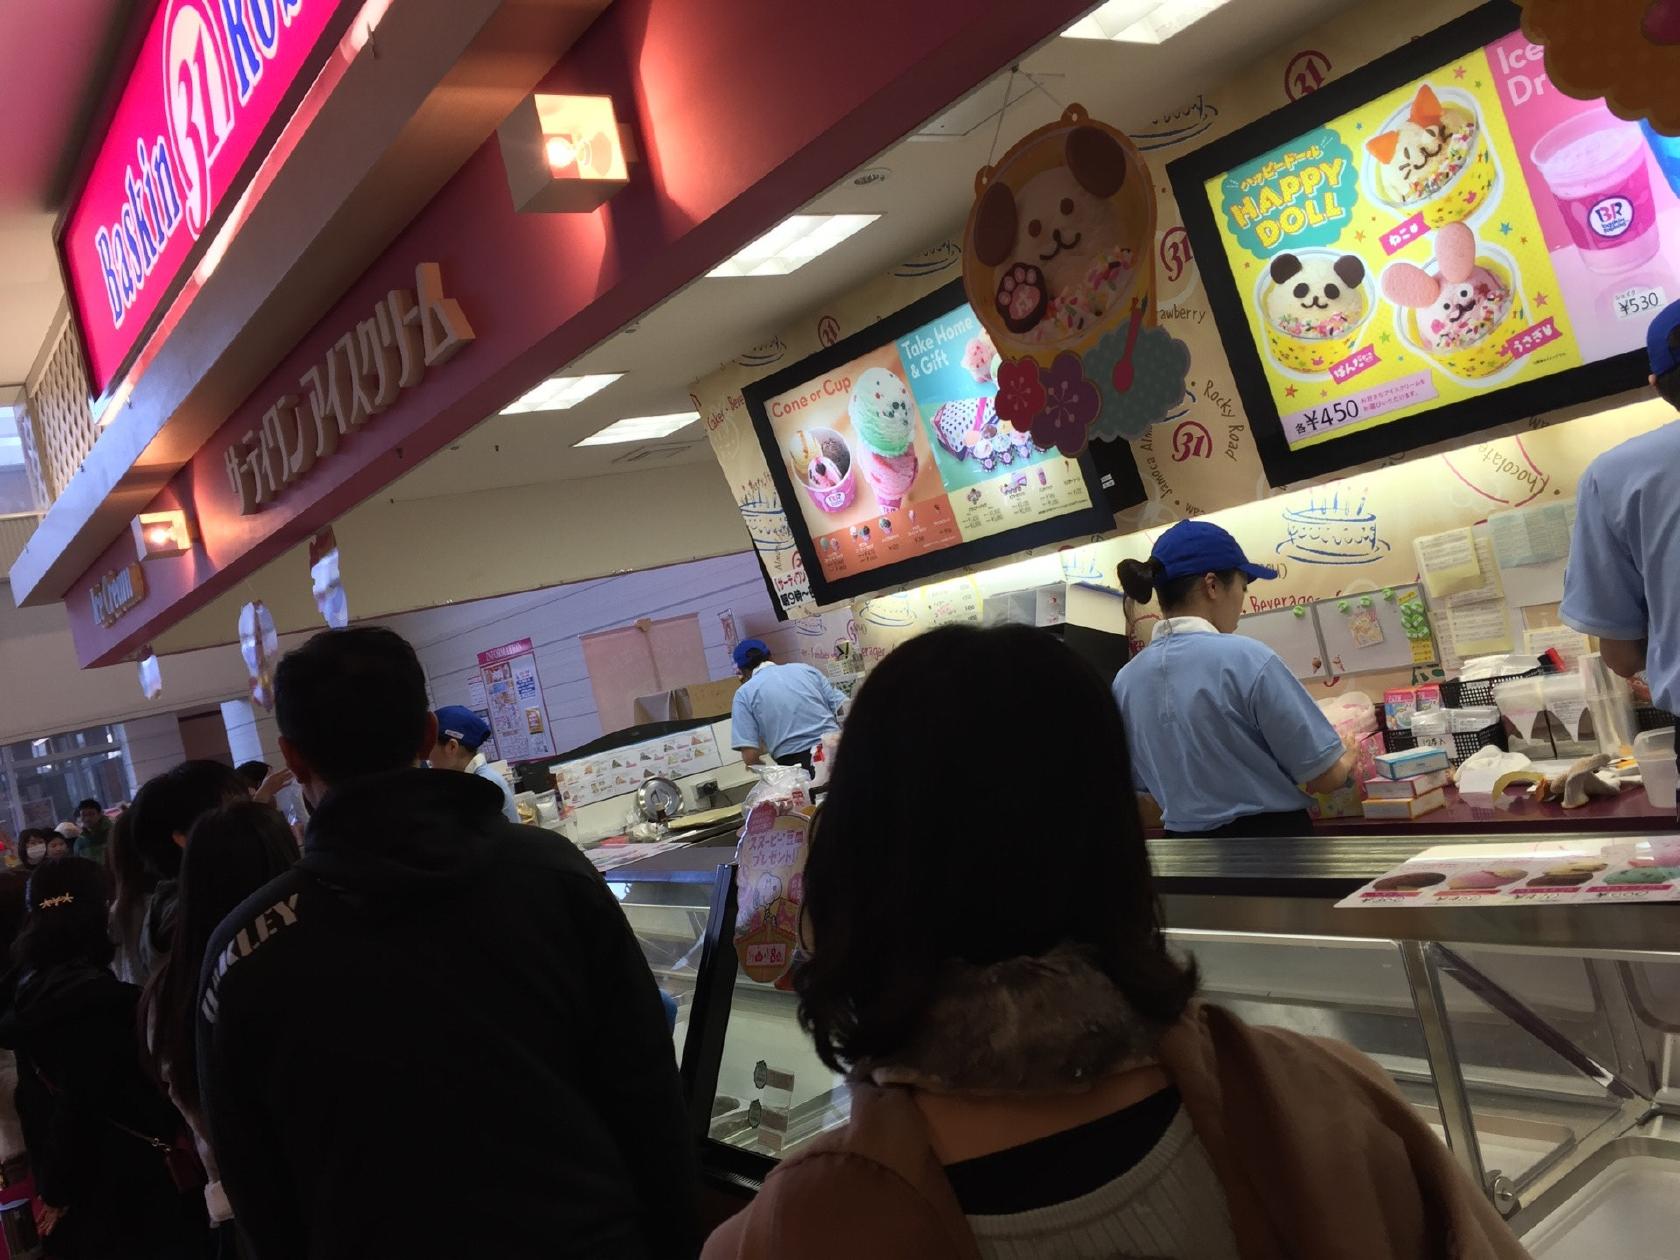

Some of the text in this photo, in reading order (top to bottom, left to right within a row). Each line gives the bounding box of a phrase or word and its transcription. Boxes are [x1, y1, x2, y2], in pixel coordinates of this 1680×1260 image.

[1496, 42, 1545, 74] Ice
[1507, 71, 1549, 107] Dr
[166, 2, 234, 238] 31
[1230, 158, 1347, 229] HAPPY
[95, 135, 183, 329] Baskin
[1255, 191, 1346, 249] DOLL
[1618, 291, 1660, 316] ¥530
[901, 315, 976, 361] Take Home
[910, 348, 951, 379] & Gift
[771, 375, 853, 418] Cone or Cup
[1203, 379, 1245, 462] Rocky Road
[1172, 426, 1210, 461] 31
